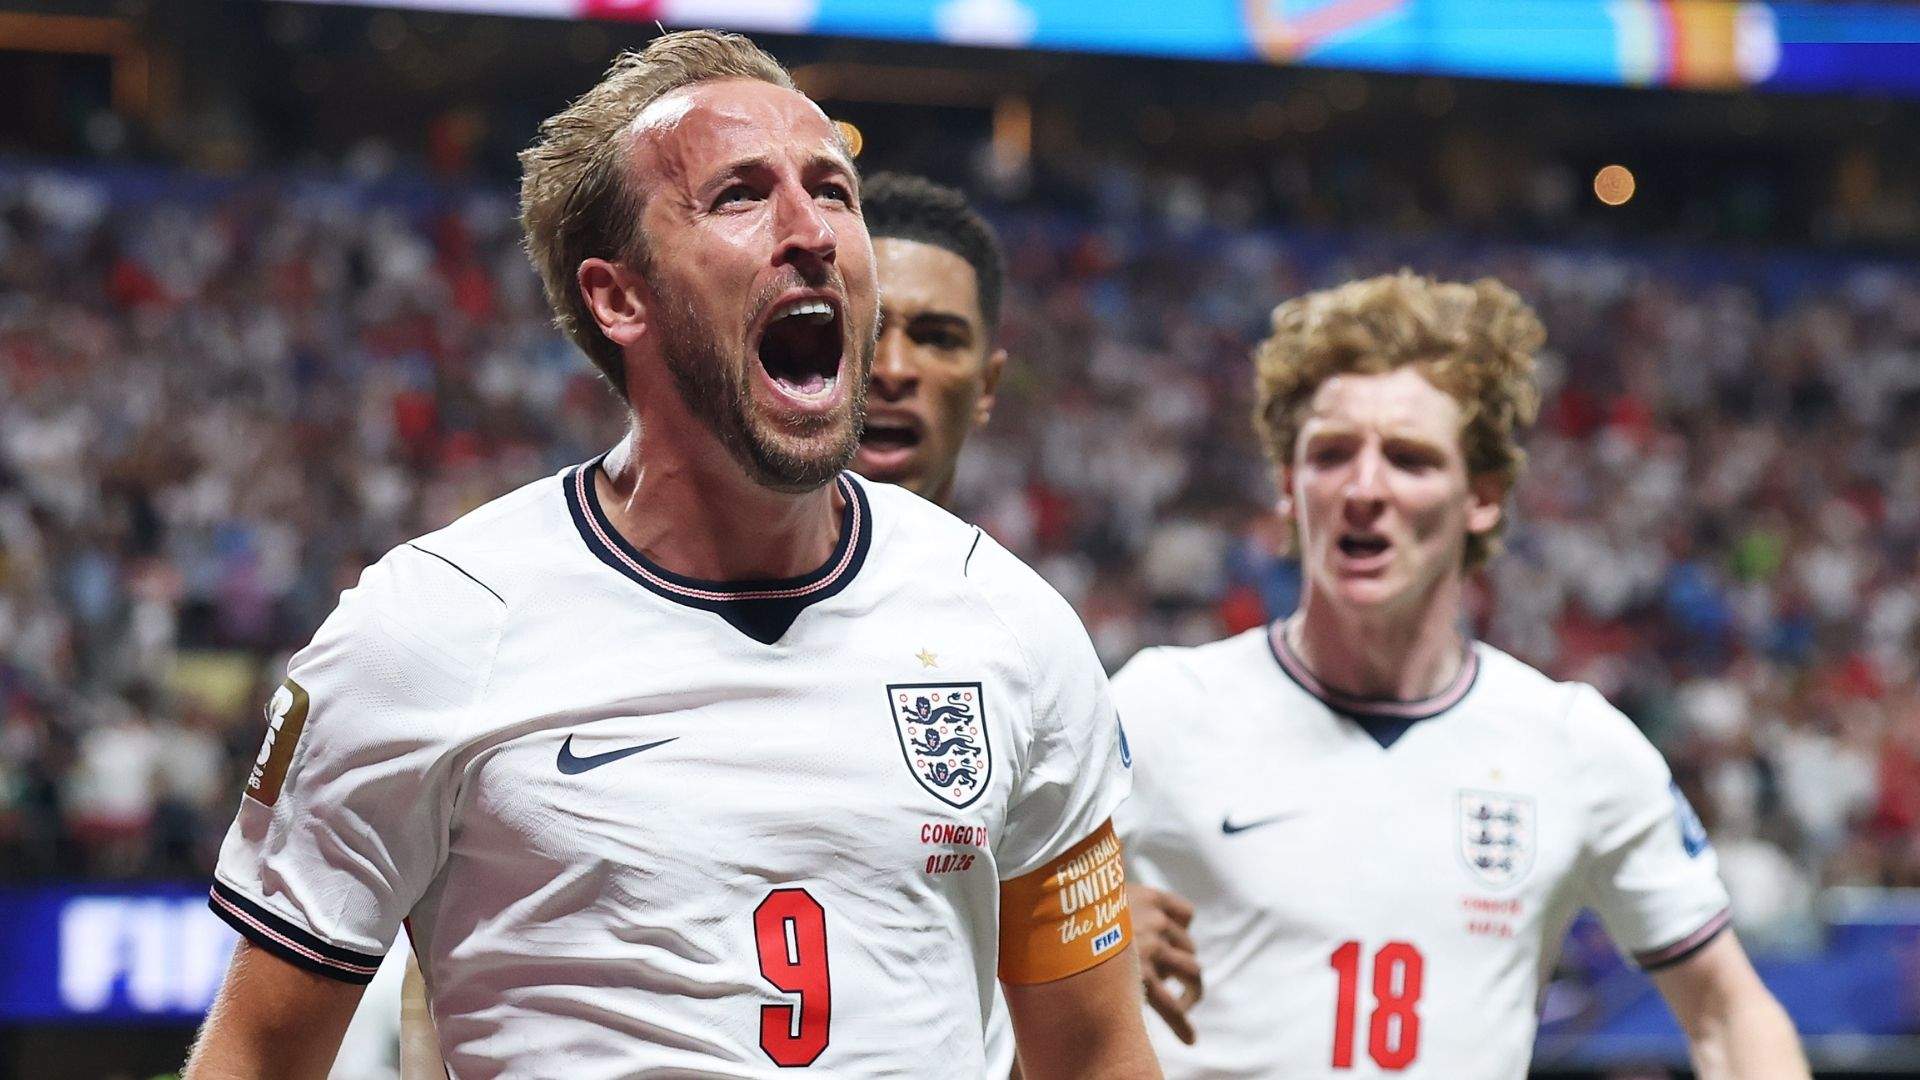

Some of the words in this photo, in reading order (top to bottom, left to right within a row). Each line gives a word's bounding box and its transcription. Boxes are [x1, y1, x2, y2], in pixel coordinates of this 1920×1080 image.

[921, 823, 973, 845] CONGO
[925, 853, 976, 874] 01.07.26
[1057, 831, 1120, 887] FOOTBALL
[1059, 853, 1125, 915] UNITES
[1057, 914, 1094, 944] the
[1095, 929, 1120, 951] FIFA
[753, 887, 832, 1068] 9
[1329, 939, 1425, 1072] 18
